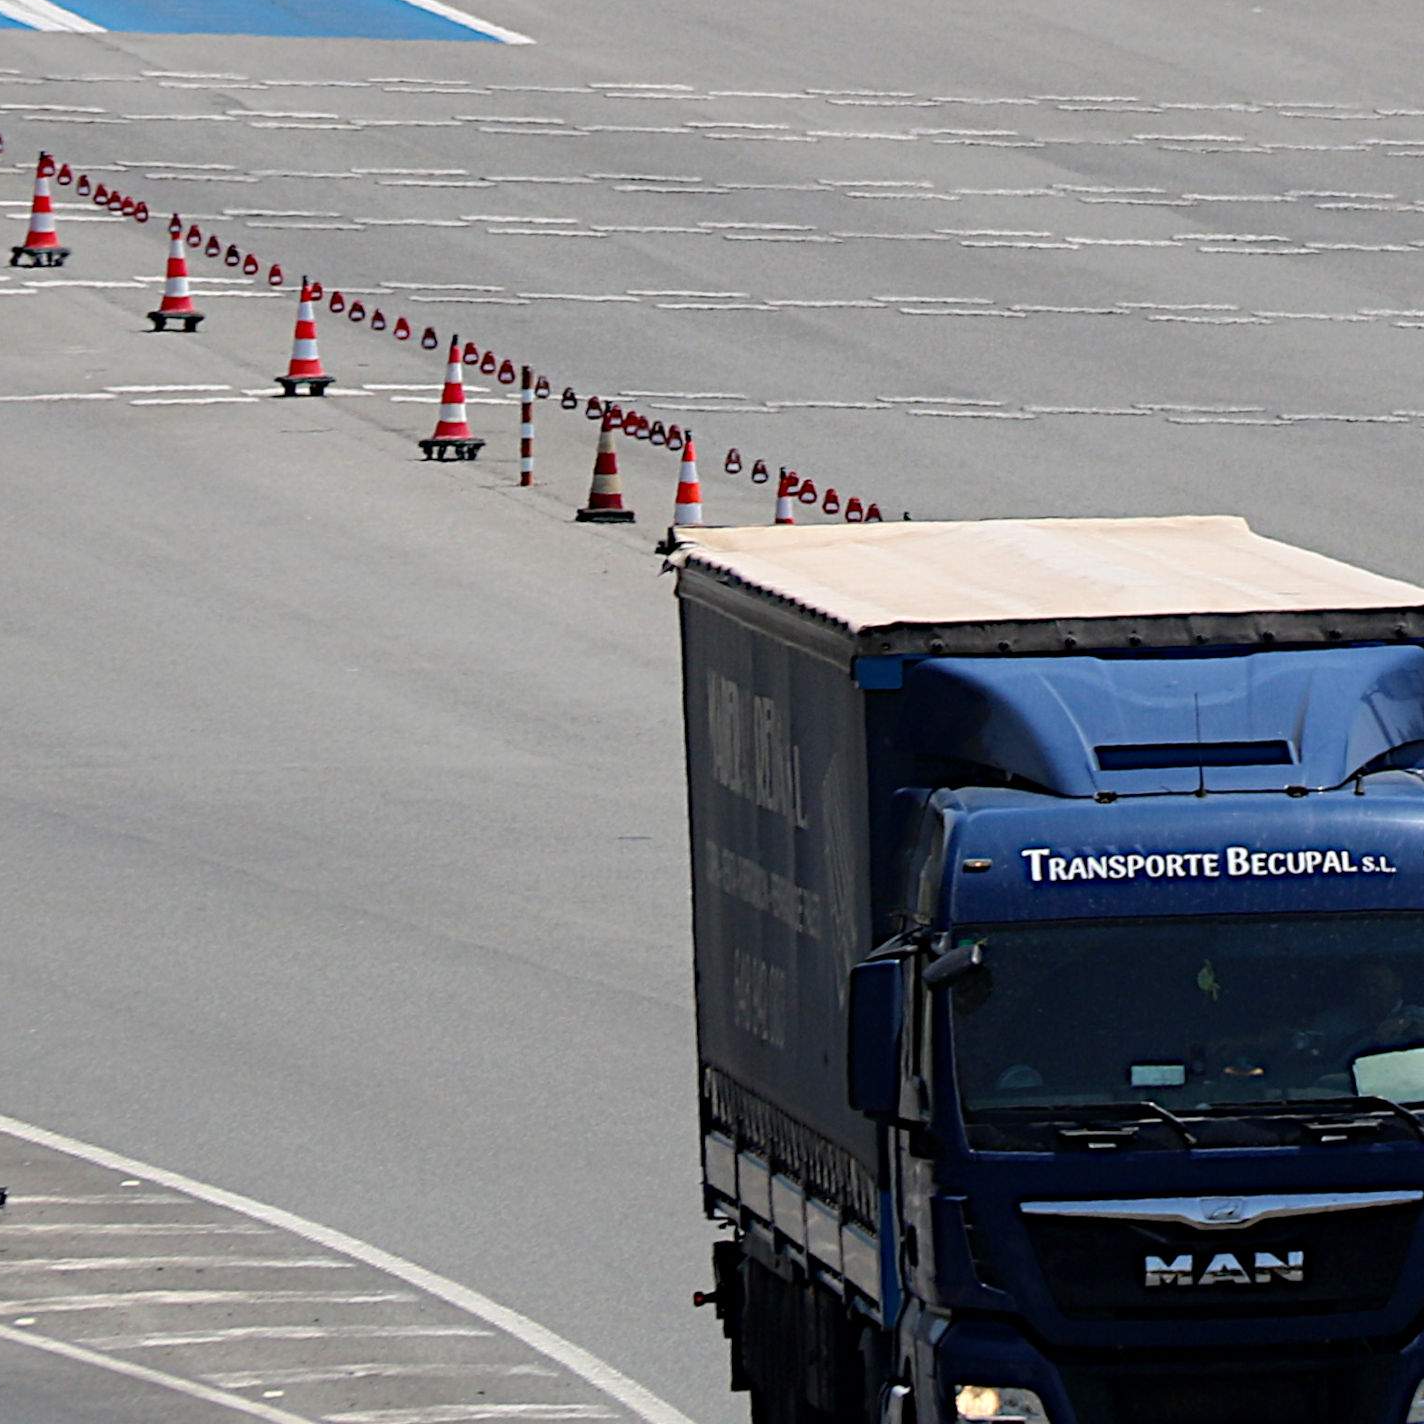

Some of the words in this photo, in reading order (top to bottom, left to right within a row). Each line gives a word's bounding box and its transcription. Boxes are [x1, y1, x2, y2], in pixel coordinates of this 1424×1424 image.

[1021, 847, 1221, 882] TRANSPORTE
[1226, 846, 1358, 877] BECUPAL
[1144, 1250, 1305, 1287] MAN
